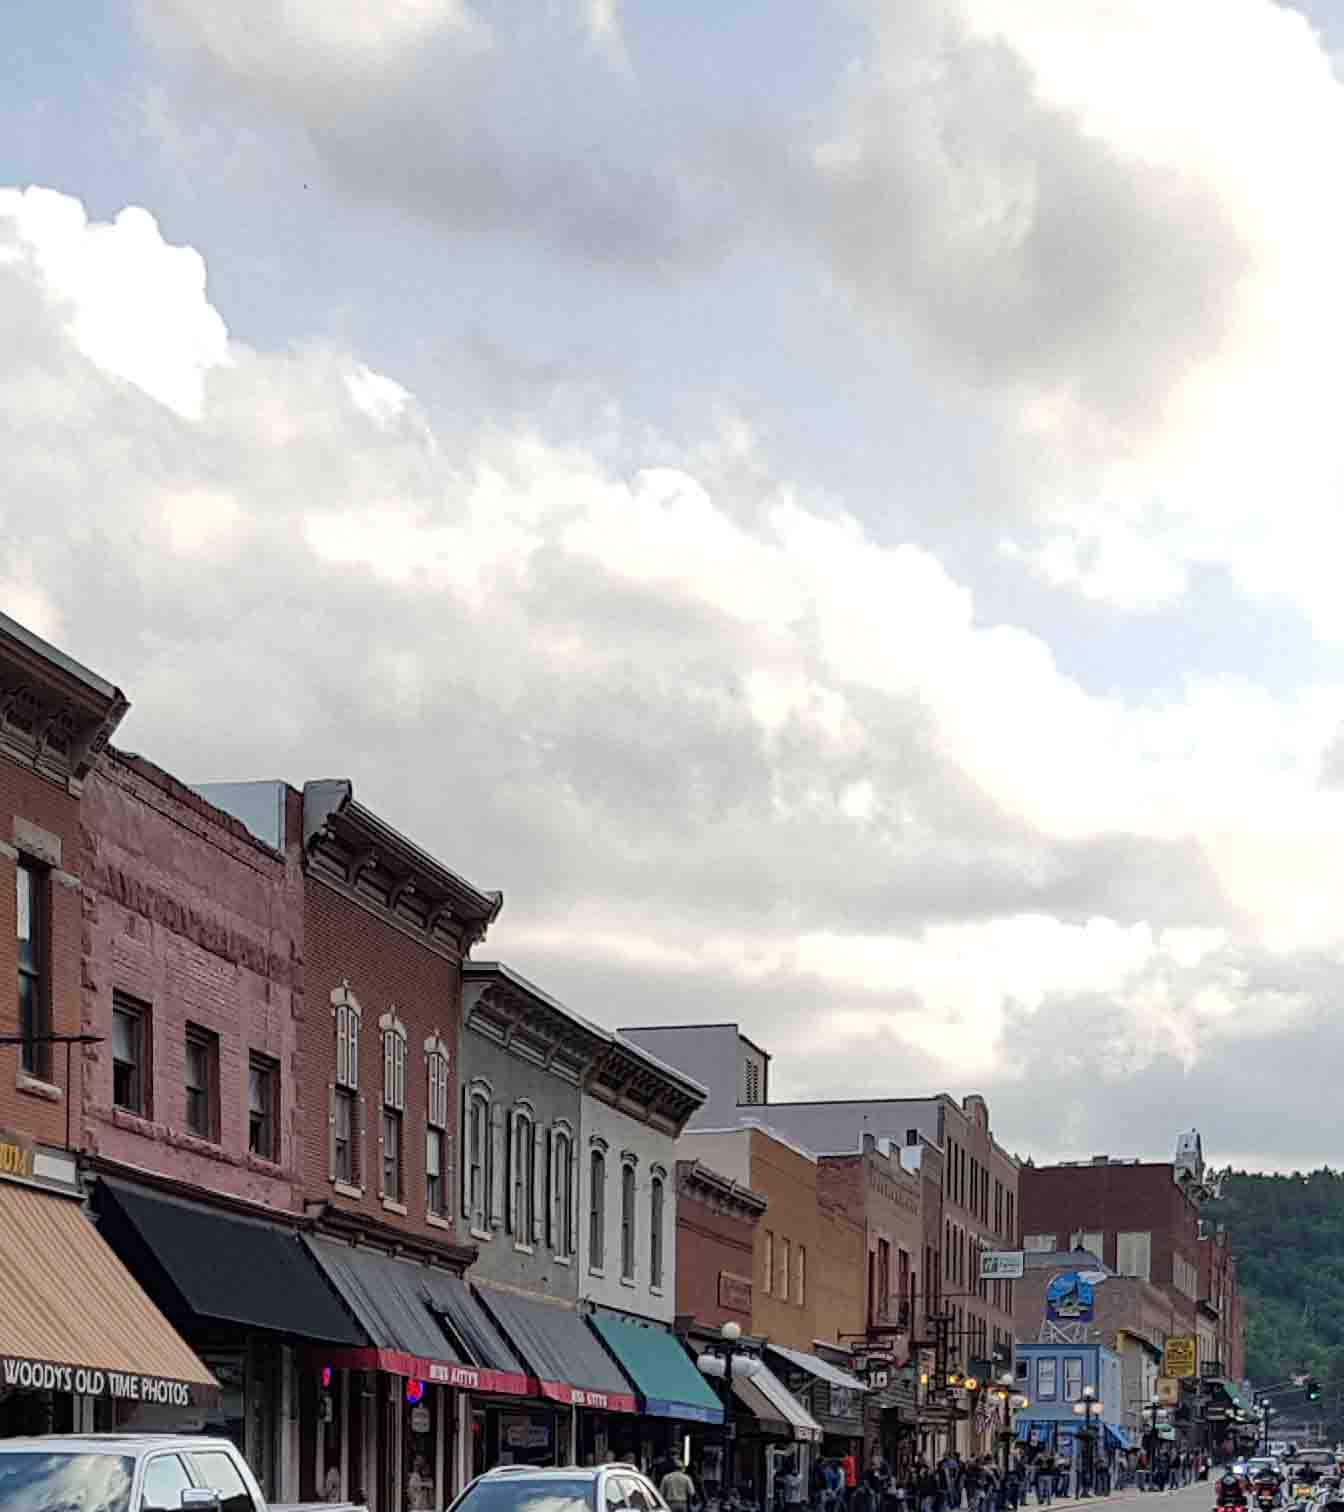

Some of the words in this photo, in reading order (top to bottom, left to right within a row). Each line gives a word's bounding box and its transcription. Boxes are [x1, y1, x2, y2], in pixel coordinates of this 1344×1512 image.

[75, 1369, 105, 1396] OLD
[107, 1372, 139, 1399] TIME
[141, 1378, 190, 1405] PHOTOS
